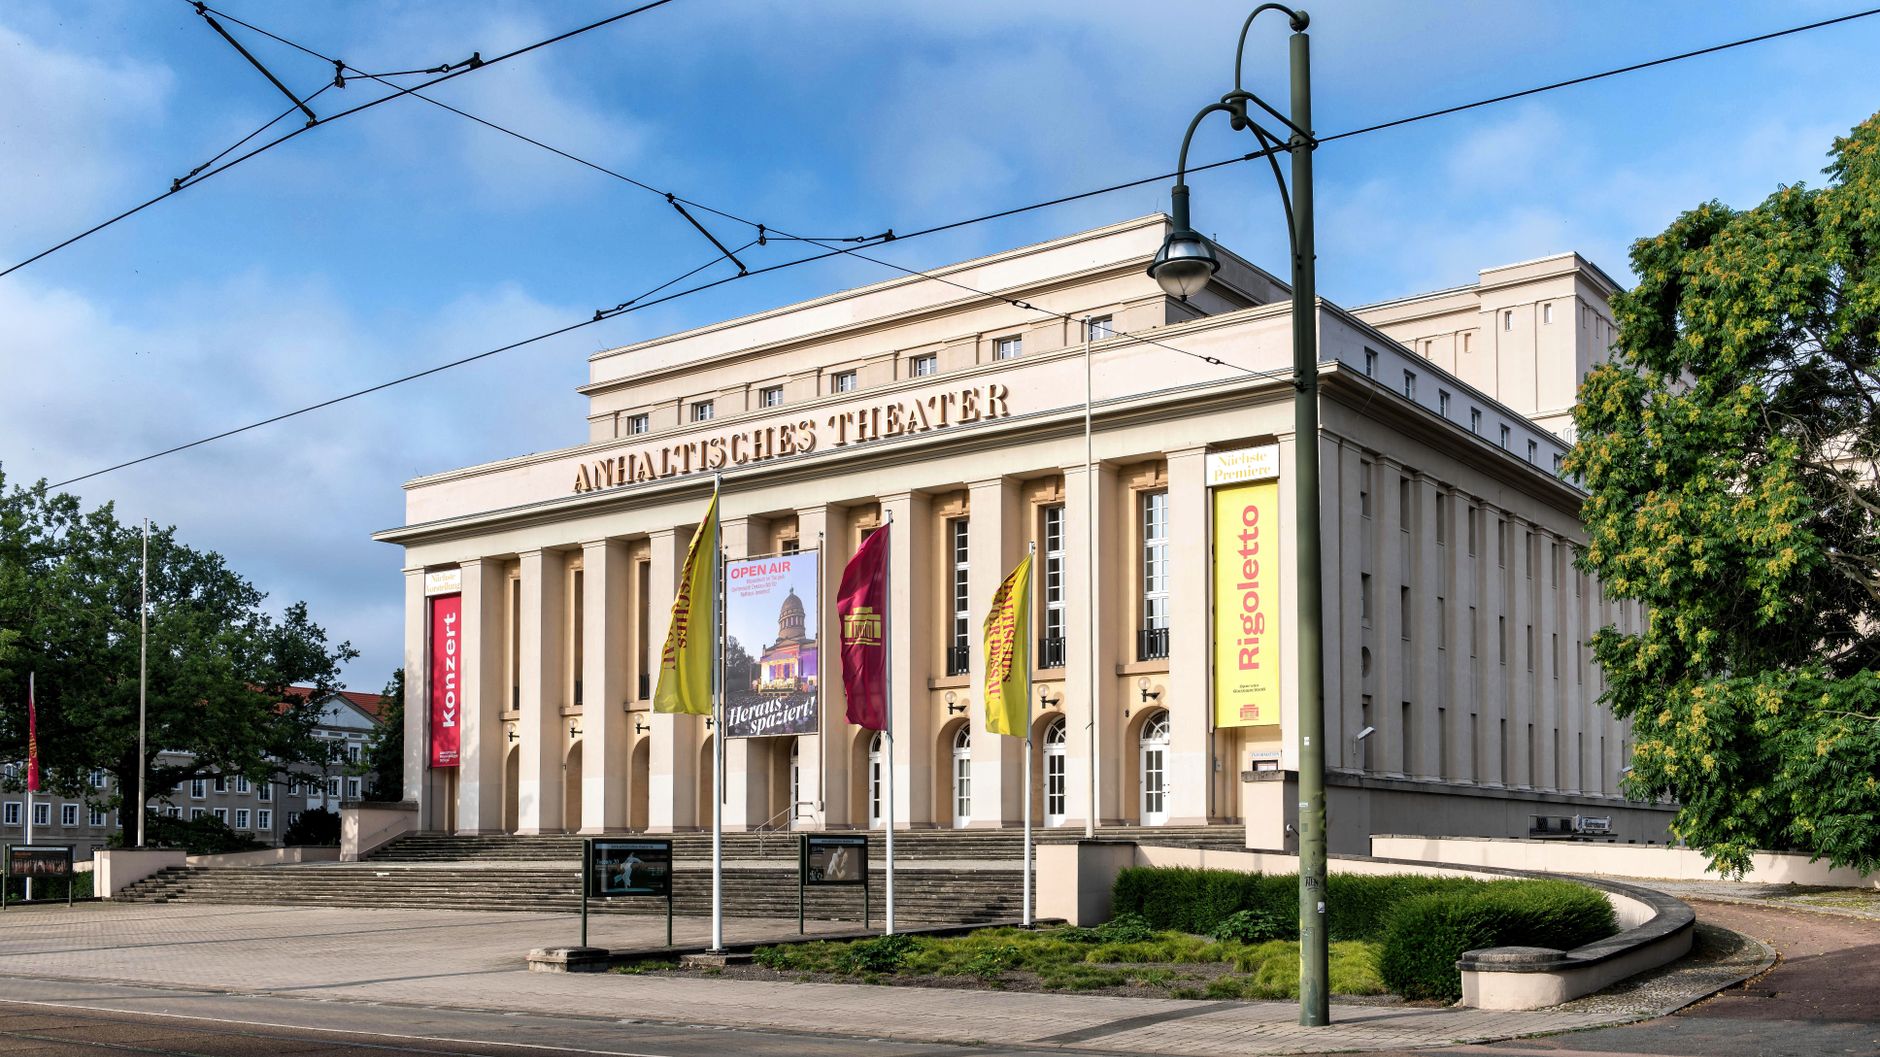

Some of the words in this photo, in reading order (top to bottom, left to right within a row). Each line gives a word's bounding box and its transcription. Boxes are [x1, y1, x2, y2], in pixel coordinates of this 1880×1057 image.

[572, 420, 816, 494] ANHALTISCHES
[827, 384, 1010, 447] THEATER
[1214, 465, 1271, 481] Premiere
[1218, 452, 1267, 467] Nächste
[730, 563, 767, 580] OPEN
[769, 561, 791, 574] AIR
[1237, 504, 1265, 671] Rigoletto
[442, 612, 456, 728] Konzert
[728, 697, 782, 727] Heraus
[750, 695, 816, 736] spaziert!
